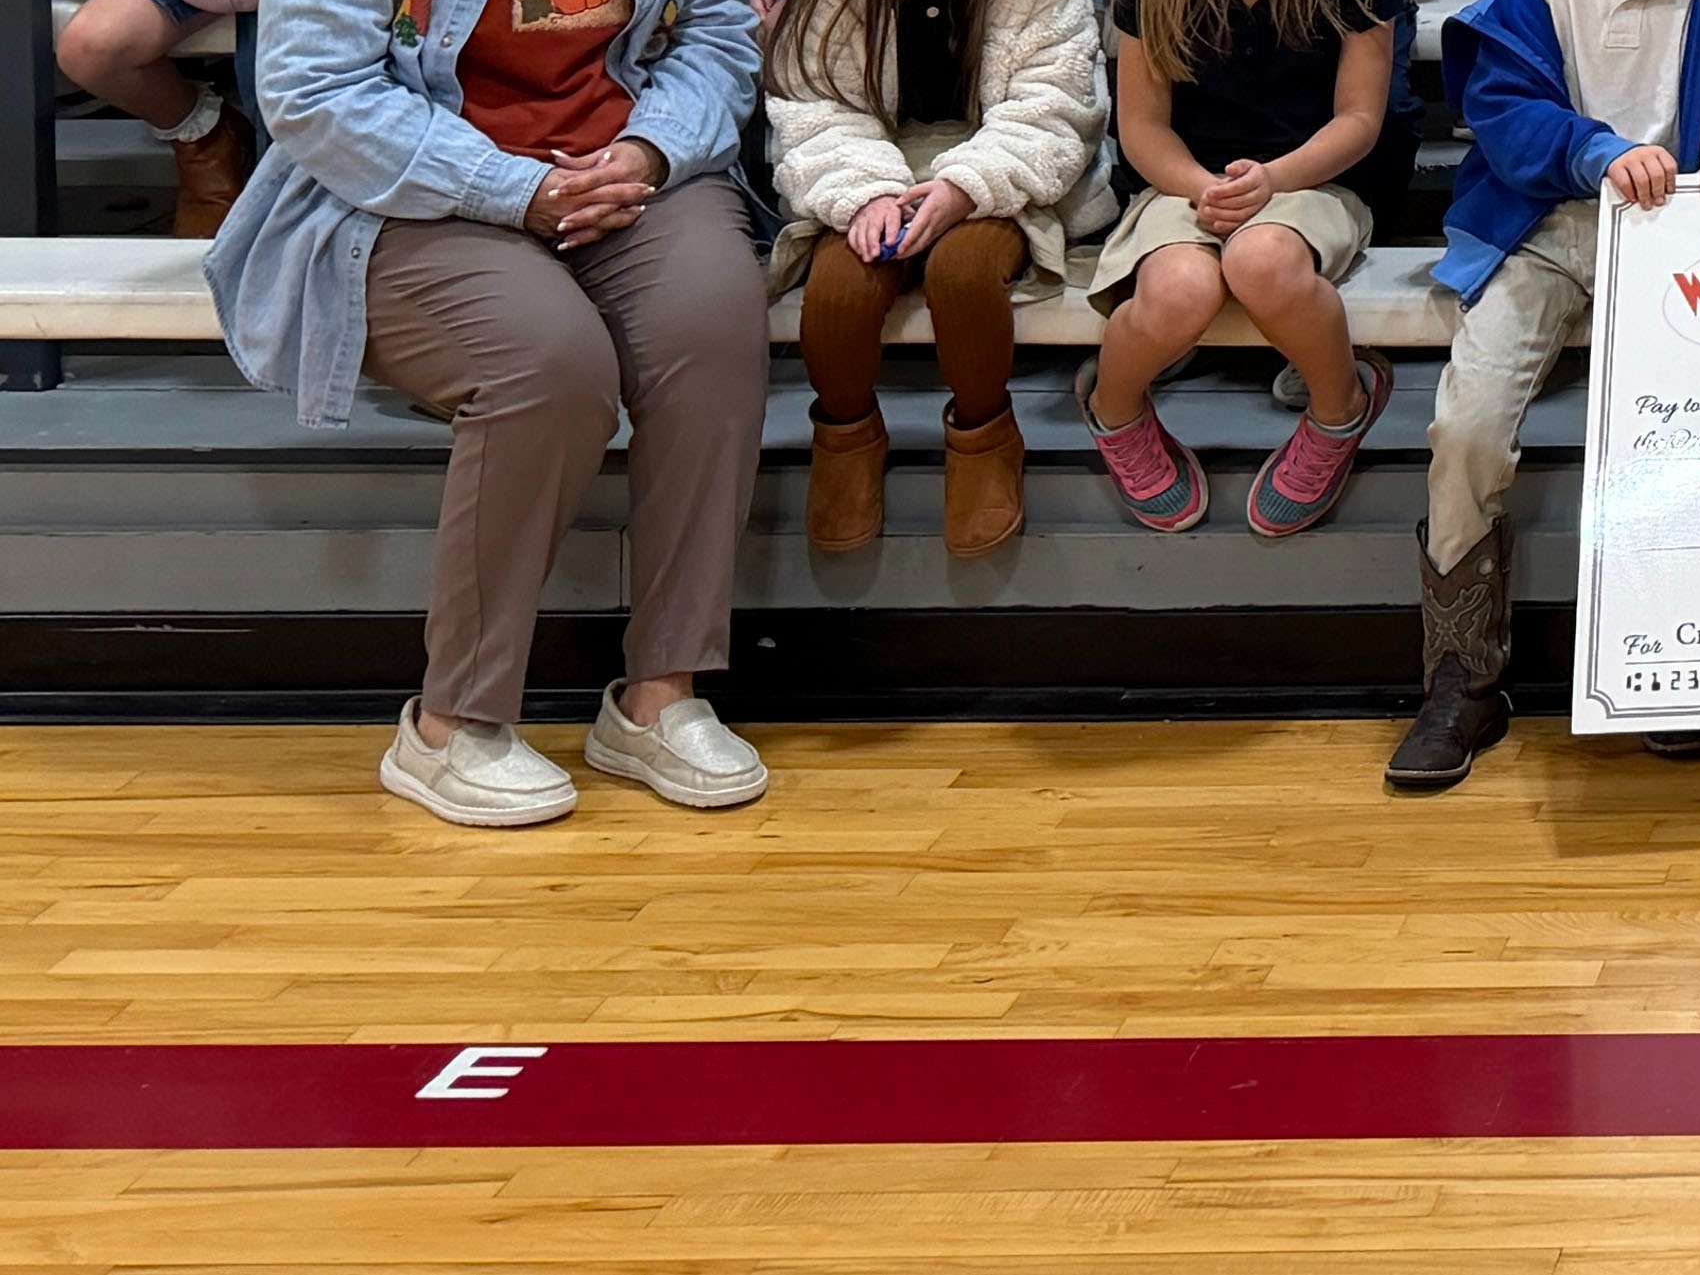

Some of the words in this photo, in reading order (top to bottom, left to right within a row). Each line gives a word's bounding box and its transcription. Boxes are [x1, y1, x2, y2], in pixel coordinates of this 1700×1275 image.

[1635, 394, 1680, 423] Pay
[1623, 634, 1664, 656] For
[414, 1047, 549, 1099] E
